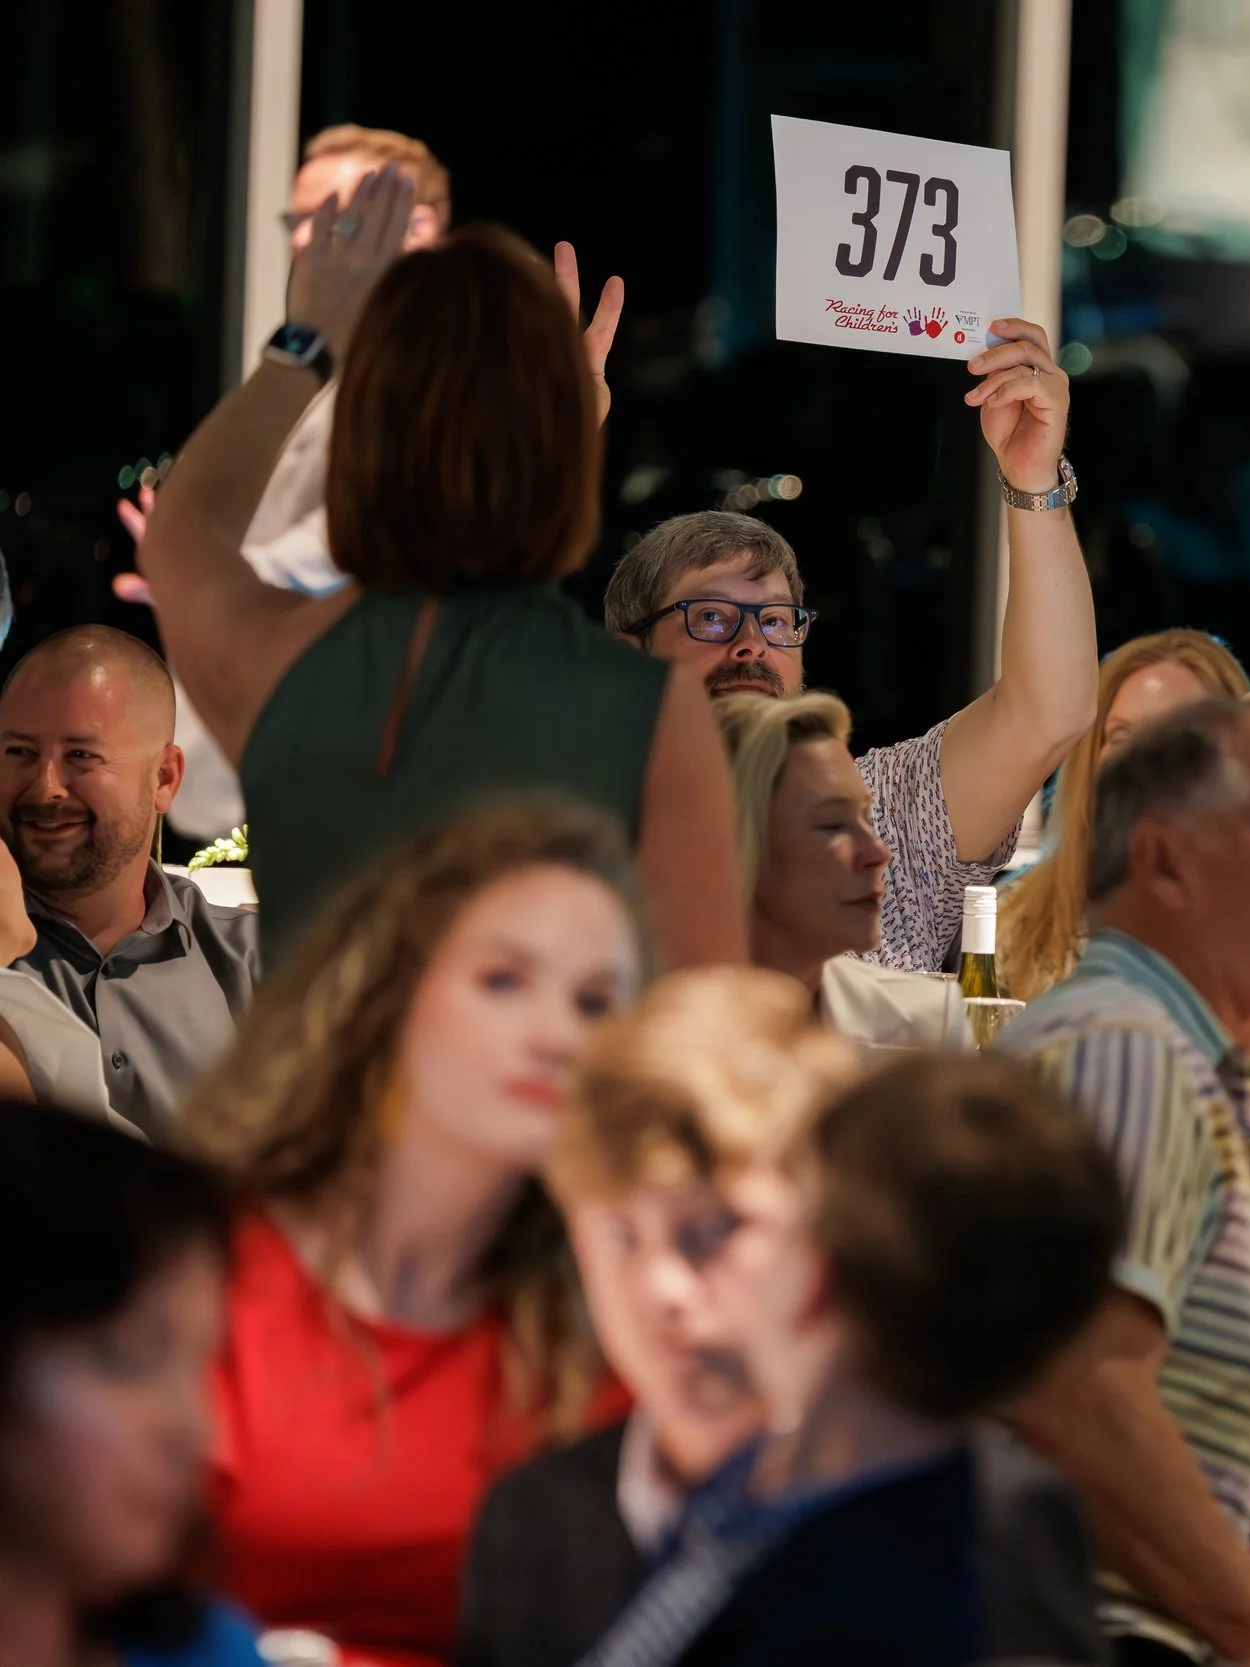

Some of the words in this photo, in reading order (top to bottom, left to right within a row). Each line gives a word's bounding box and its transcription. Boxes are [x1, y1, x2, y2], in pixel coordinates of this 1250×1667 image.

[835, 165, 959, 287] 373
[826, 299, 875, 321] Racing
[877, 304, 899, 322] for
[834, 315, 899, 334] Children's
